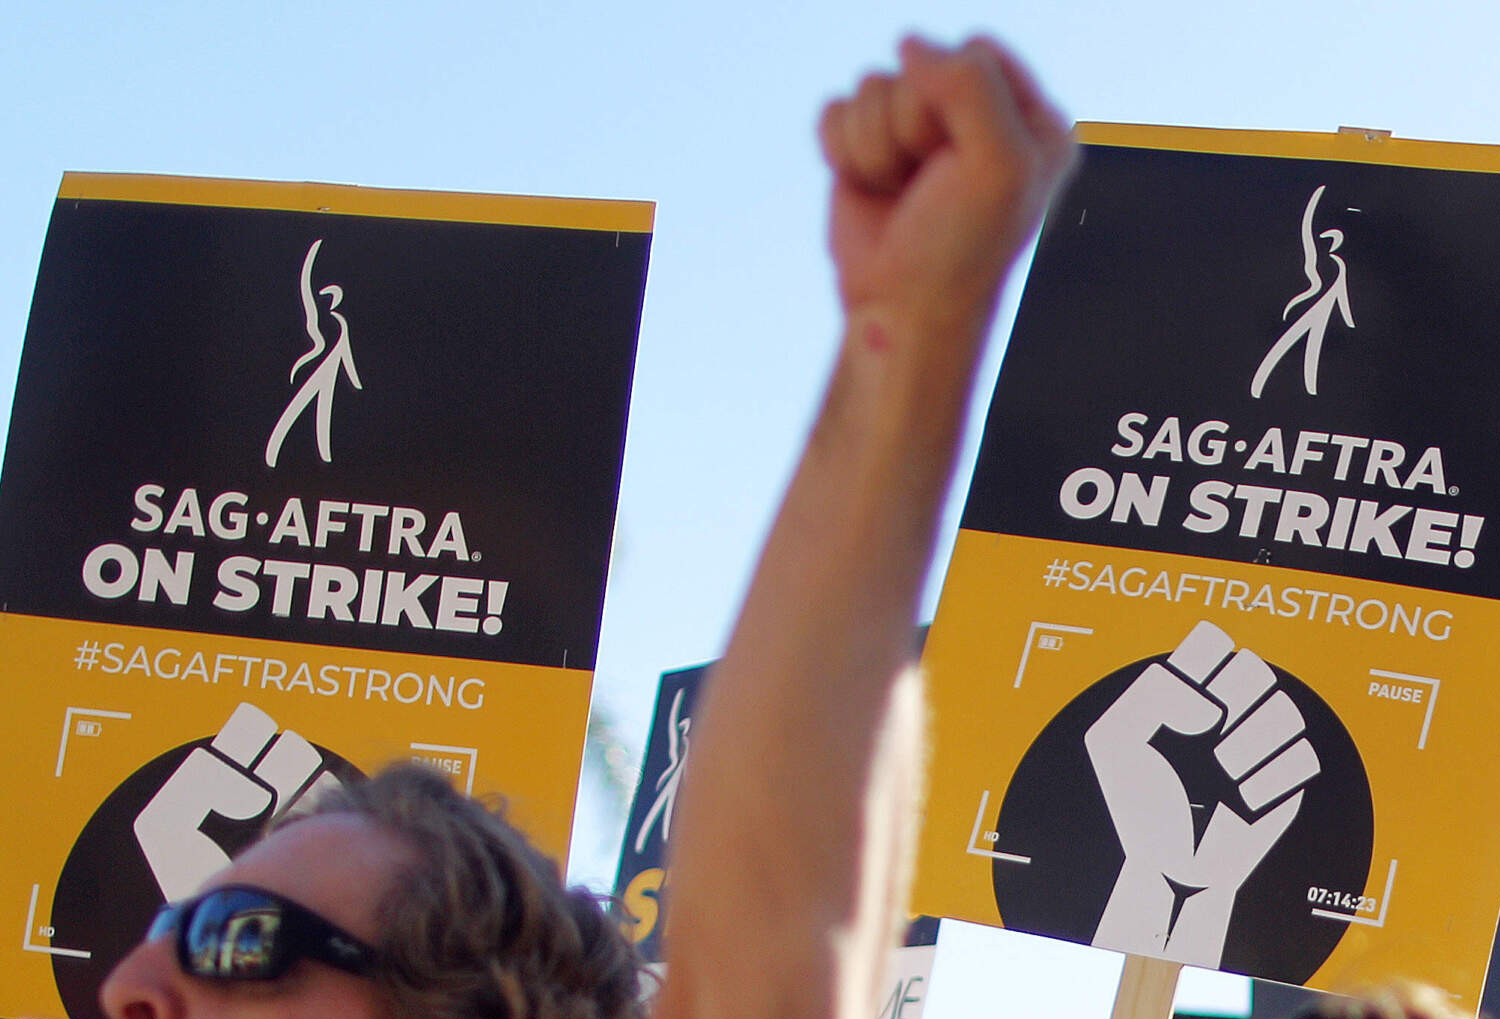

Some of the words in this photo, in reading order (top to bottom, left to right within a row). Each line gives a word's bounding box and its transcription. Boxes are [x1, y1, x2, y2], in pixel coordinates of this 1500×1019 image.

[1059, 467, 1170, 526] ON
[1182, 480, 1485, 569] STRIKE!
[82, 542, 194, 605] ON
[212, 555, 509, 636] STRIKE!
[1043, 558, 1454, 642] #SAGAFTRASTRONG
[74, 639, 486, 710] #SAGAFTRASTRONG
[1368, 682, 1424, 703] PAUSE
[983, 830, 1000, 842] HD
[1307, 886, 1377, 913] 07:14:23
[39, 926, 55, 938] HD
